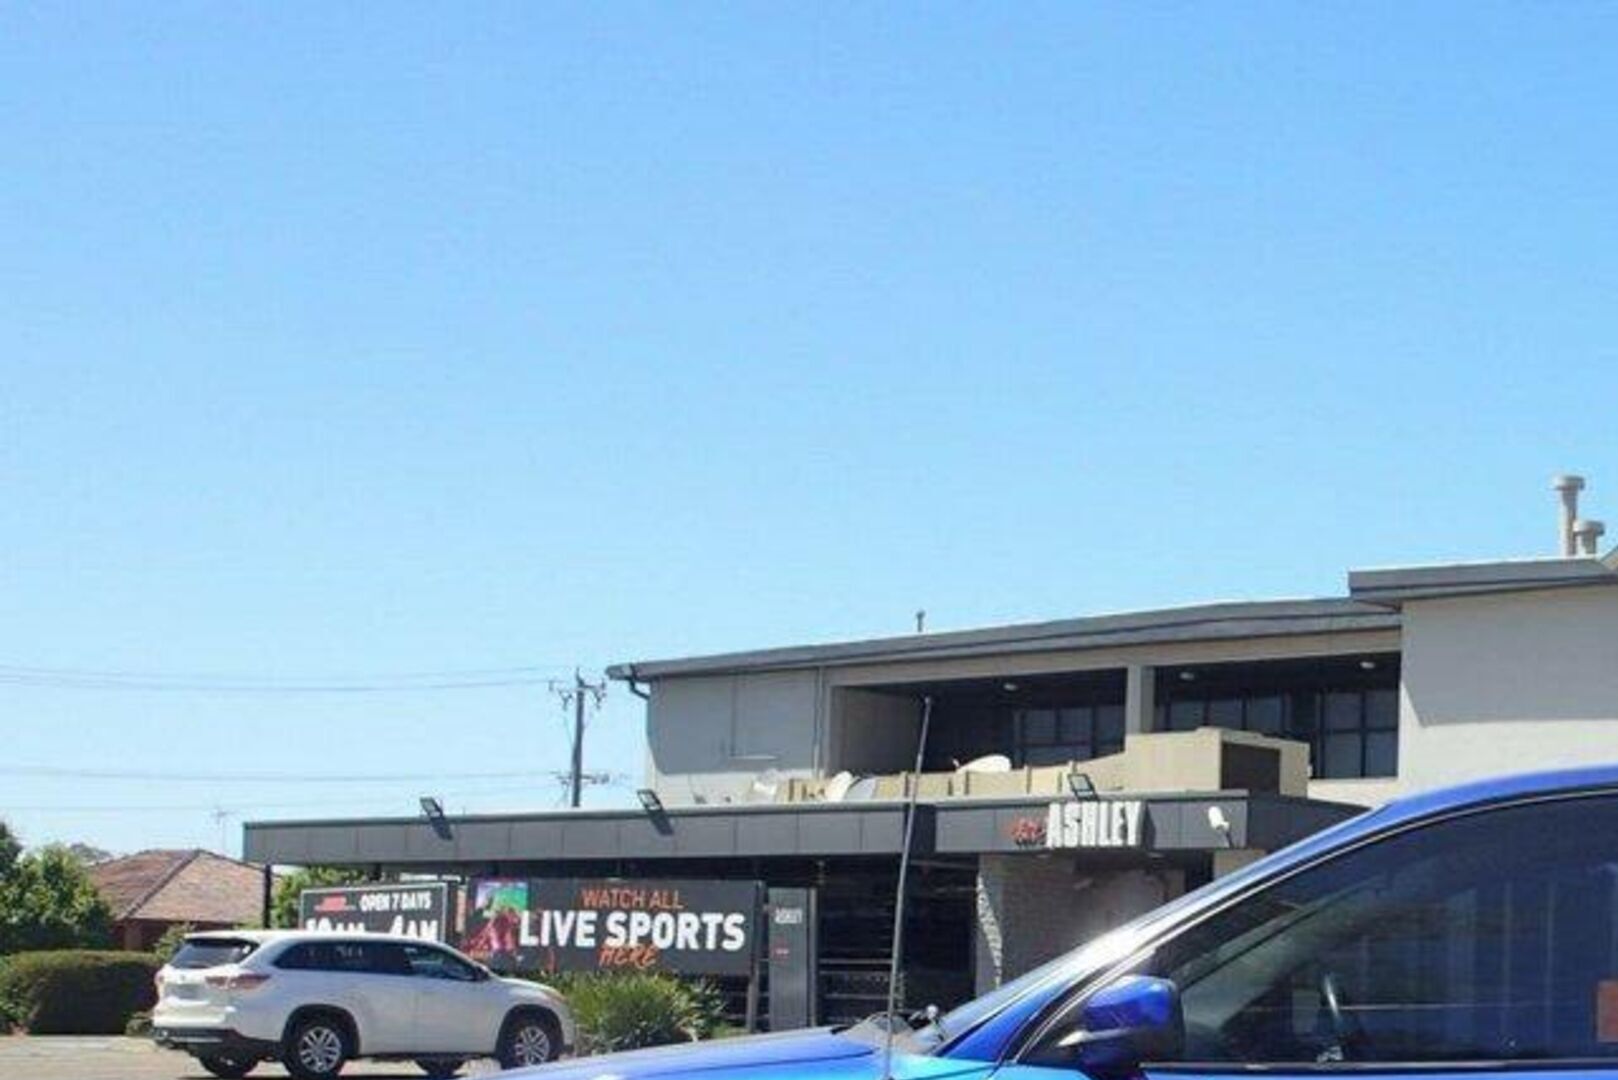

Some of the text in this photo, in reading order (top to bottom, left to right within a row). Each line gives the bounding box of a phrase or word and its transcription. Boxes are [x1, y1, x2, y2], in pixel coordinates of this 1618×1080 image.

[1045, 801, 1142, 848] ASHLEY
[360, 893, 391, 912] OPEN
[392, 892, 400, 911] 7
[402, 890, 432, 911] DAYS
[582, 889, 684, 910] WATCH ALL
[519, 910, 596, 947] LIVE
[605, 911, 746, 951] SPORTS
[600, 945, 658, 968] HERE
